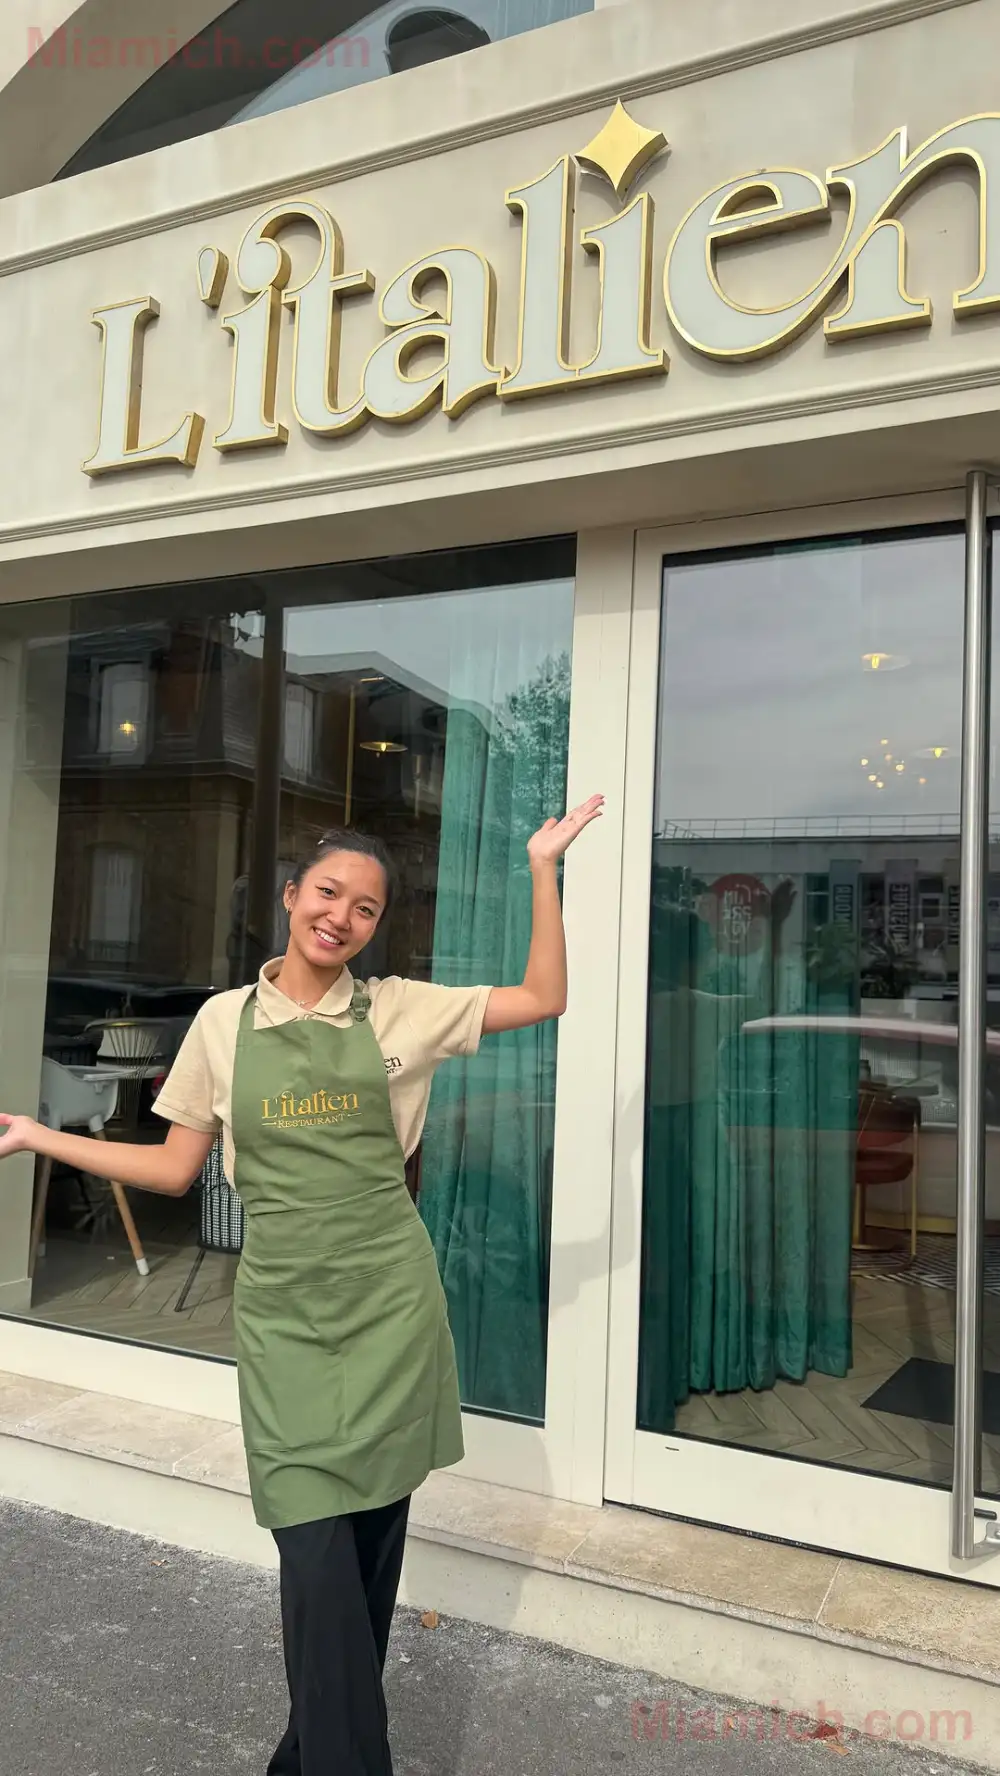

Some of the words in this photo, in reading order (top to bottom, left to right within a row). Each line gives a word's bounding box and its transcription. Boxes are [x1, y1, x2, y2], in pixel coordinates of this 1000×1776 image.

[81, 98, 1000, 478] L'italien
[261, 1088, 360, 1119] L'italien
[277, 1113, 346, 1129] RESTAURANT
